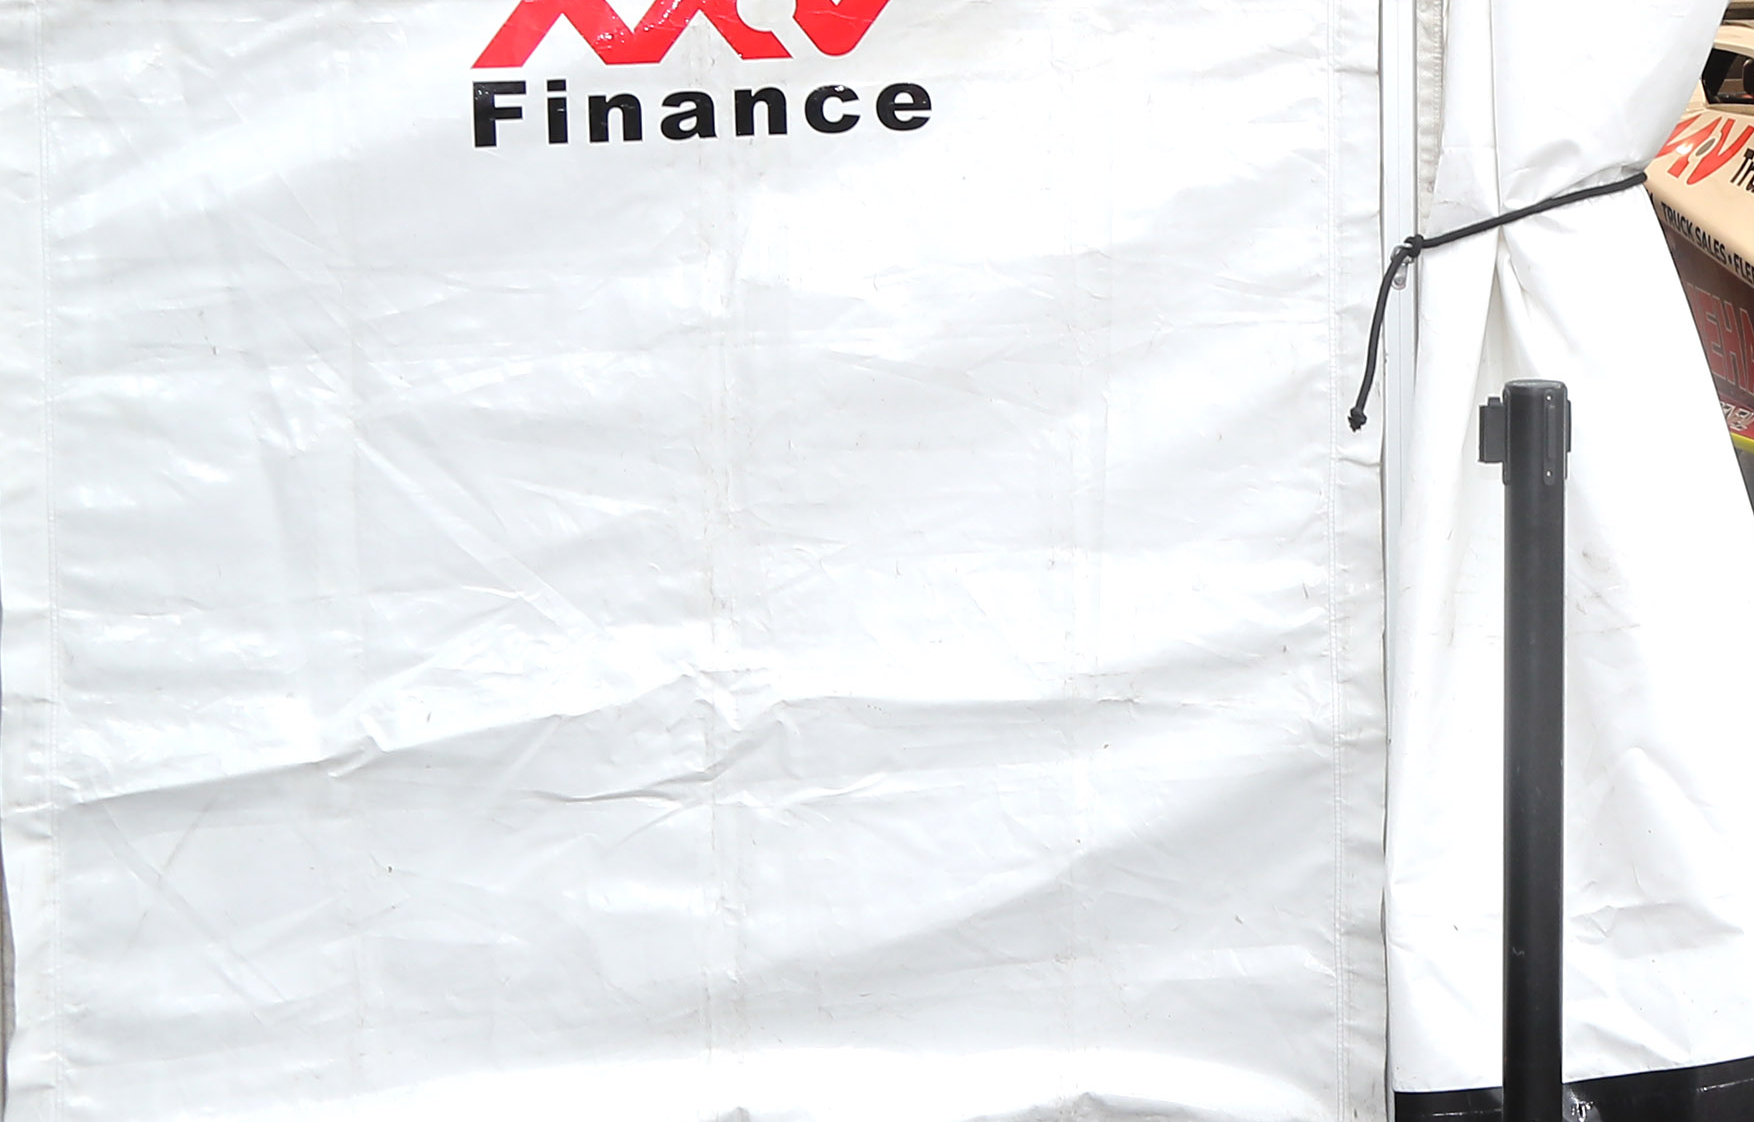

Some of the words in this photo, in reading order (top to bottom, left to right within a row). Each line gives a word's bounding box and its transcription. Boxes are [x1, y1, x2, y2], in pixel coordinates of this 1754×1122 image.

[473, 79, 932, 147] Finance
[1660, 201, 1693, 241] TRUCK
[1694, 226, 1727, 266] SALES
